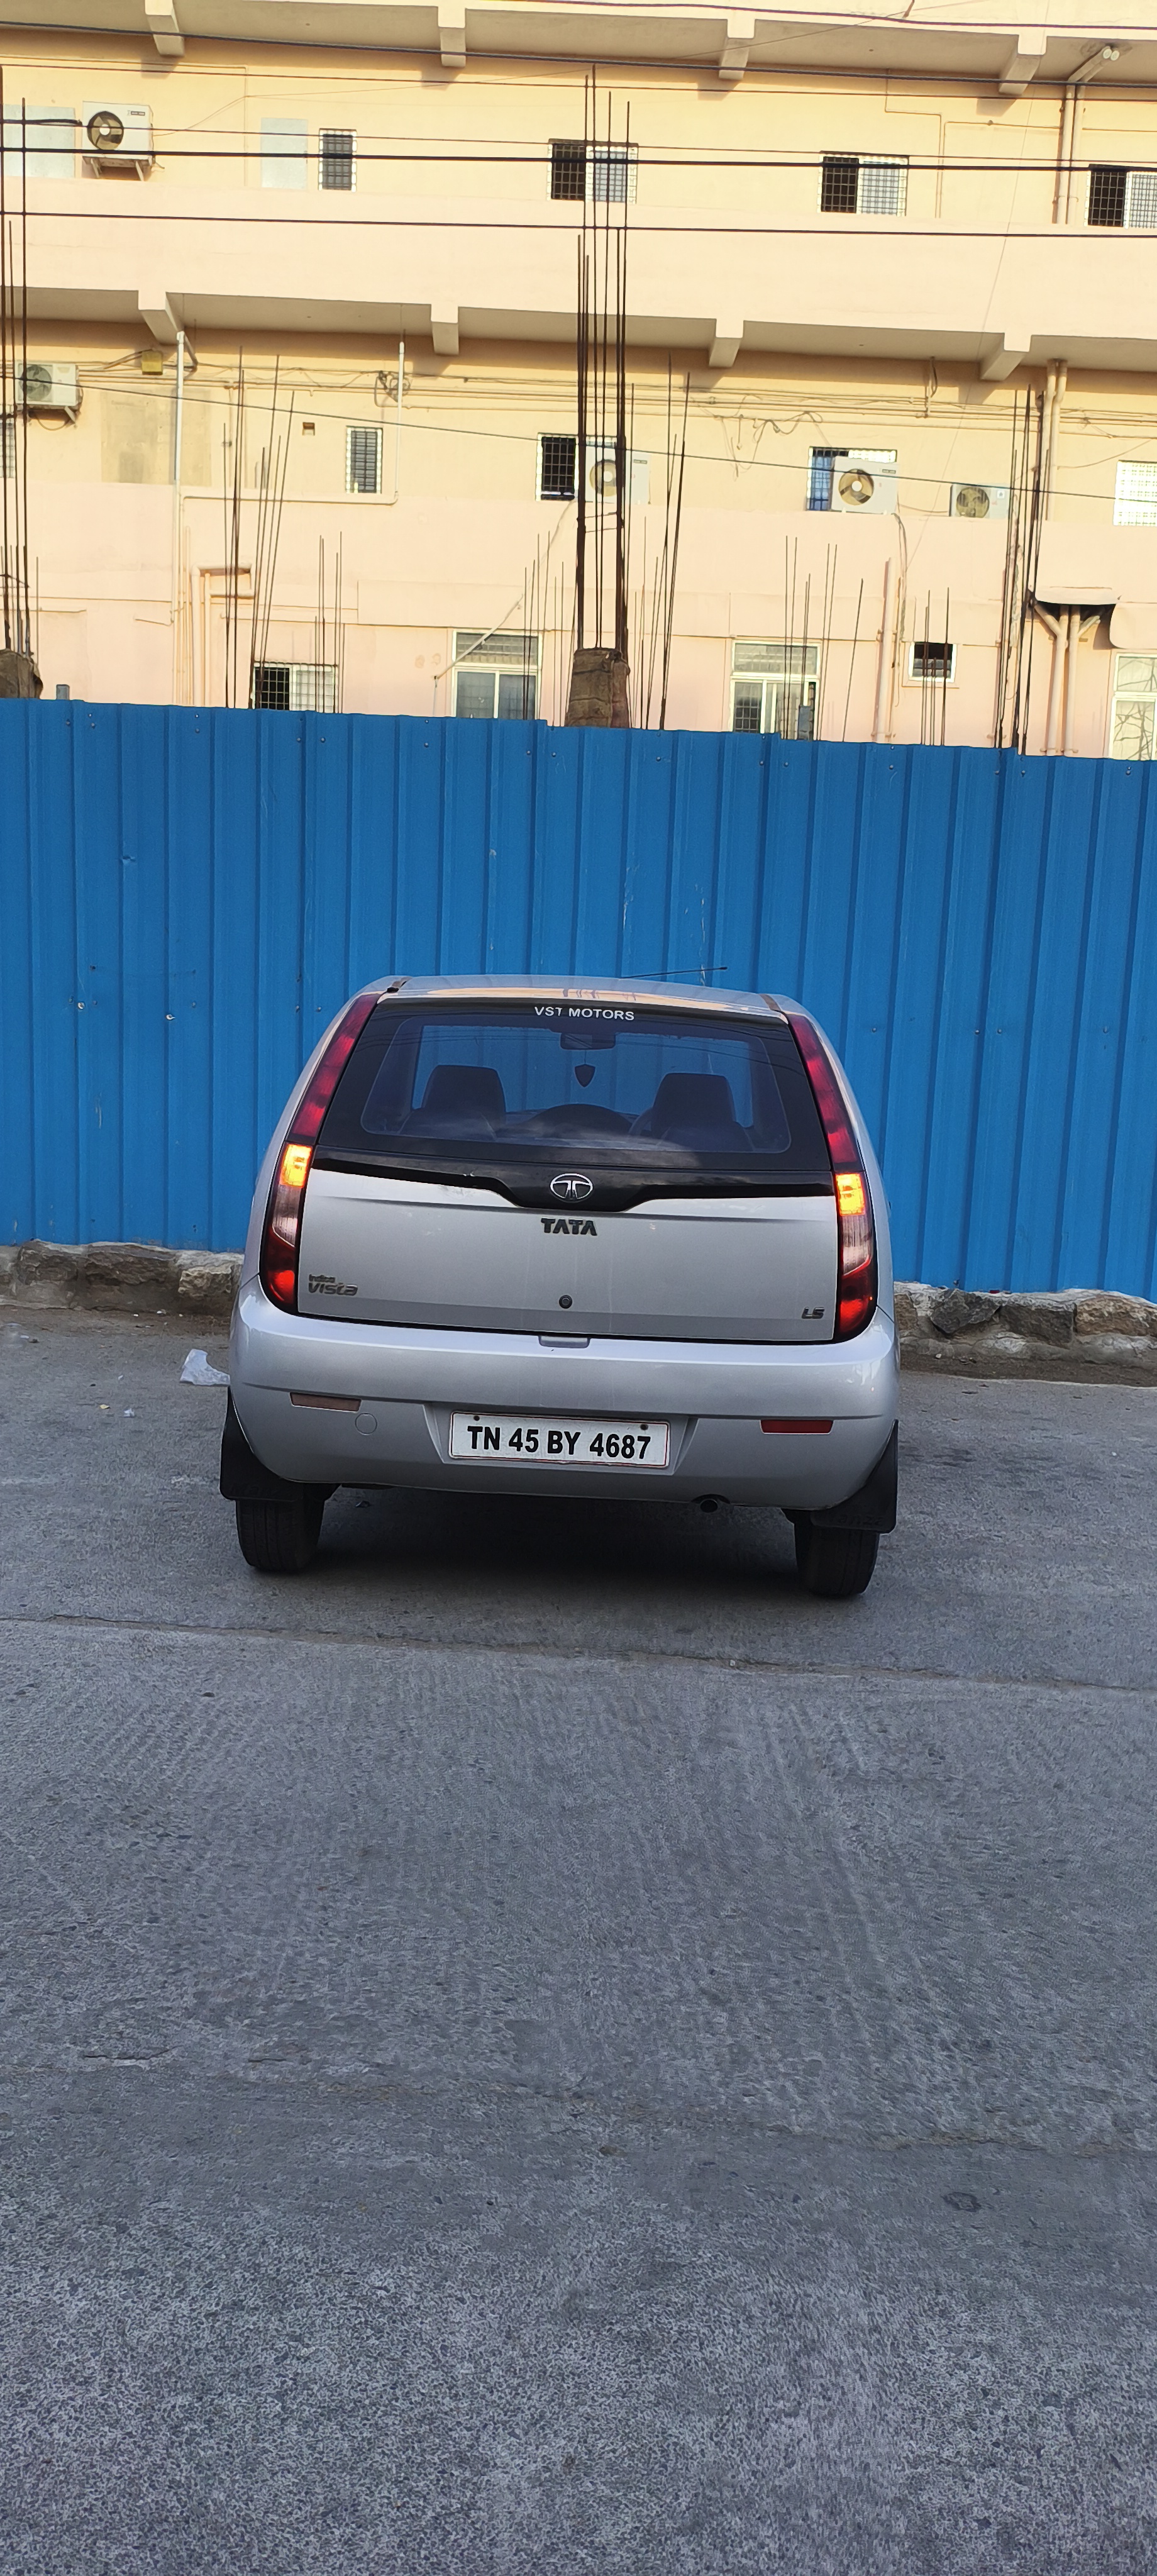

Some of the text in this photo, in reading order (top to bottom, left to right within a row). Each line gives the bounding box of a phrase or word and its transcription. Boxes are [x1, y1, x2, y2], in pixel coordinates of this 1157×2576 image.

[534, 1006, 634, 1021] VST MOTORS
[541, 1218, 597, 1236] TATA
[801, 1307, 825, 1319] LS
[467, 1425, 651, 1460] TN 45 BY 4687
